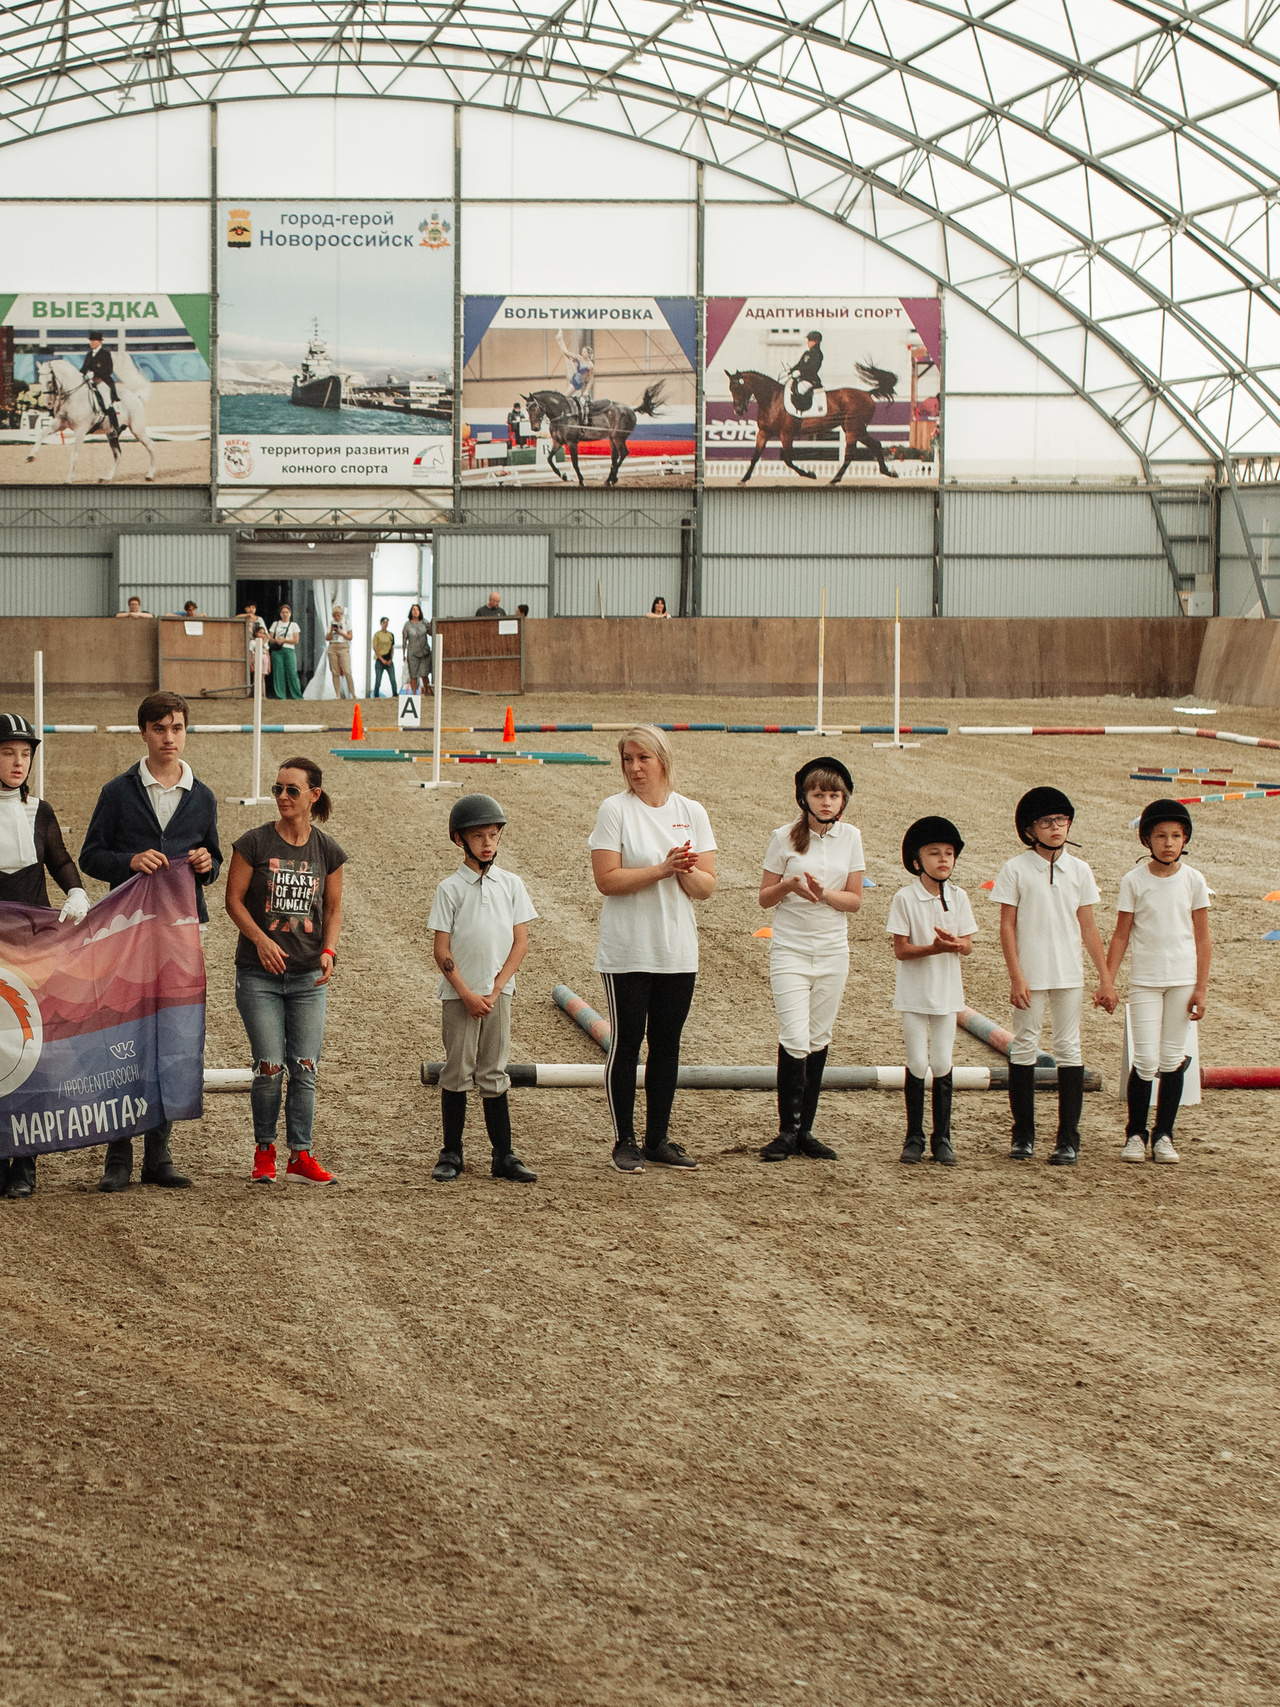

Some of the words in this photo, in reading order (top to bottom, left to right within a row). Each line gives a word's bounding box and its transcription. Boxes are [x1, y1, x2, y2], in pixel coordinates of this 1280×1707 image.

[280, 211, 394, 228] город-герой
[260, 230, 414, 250] Новороссийск
[32, 301, 160, 321] ВЫЕЗДКА
[504, 307, 653, 320] ВОЛЬТИЖИРОВКА
[745, 306, 849, 319] АДАПТИВНЫЙ
[854, 308, 903, 318] СПОРТ
[260, 445, 340, 456] территория
[346, 445, 409, 456] развития
[282, 464, 336, 474] конного
[341, 464, 388, 475] спорта
[400, 697, 418, 718] A
[276, 873, 314, 887] HEART
[275, 886, 288, 898] OF
[291, 886, 312, 900] THE
[274, 899, 310, 911] JUNGLE
[10, 1094, 148, 1147] МАРГАРИТА»
